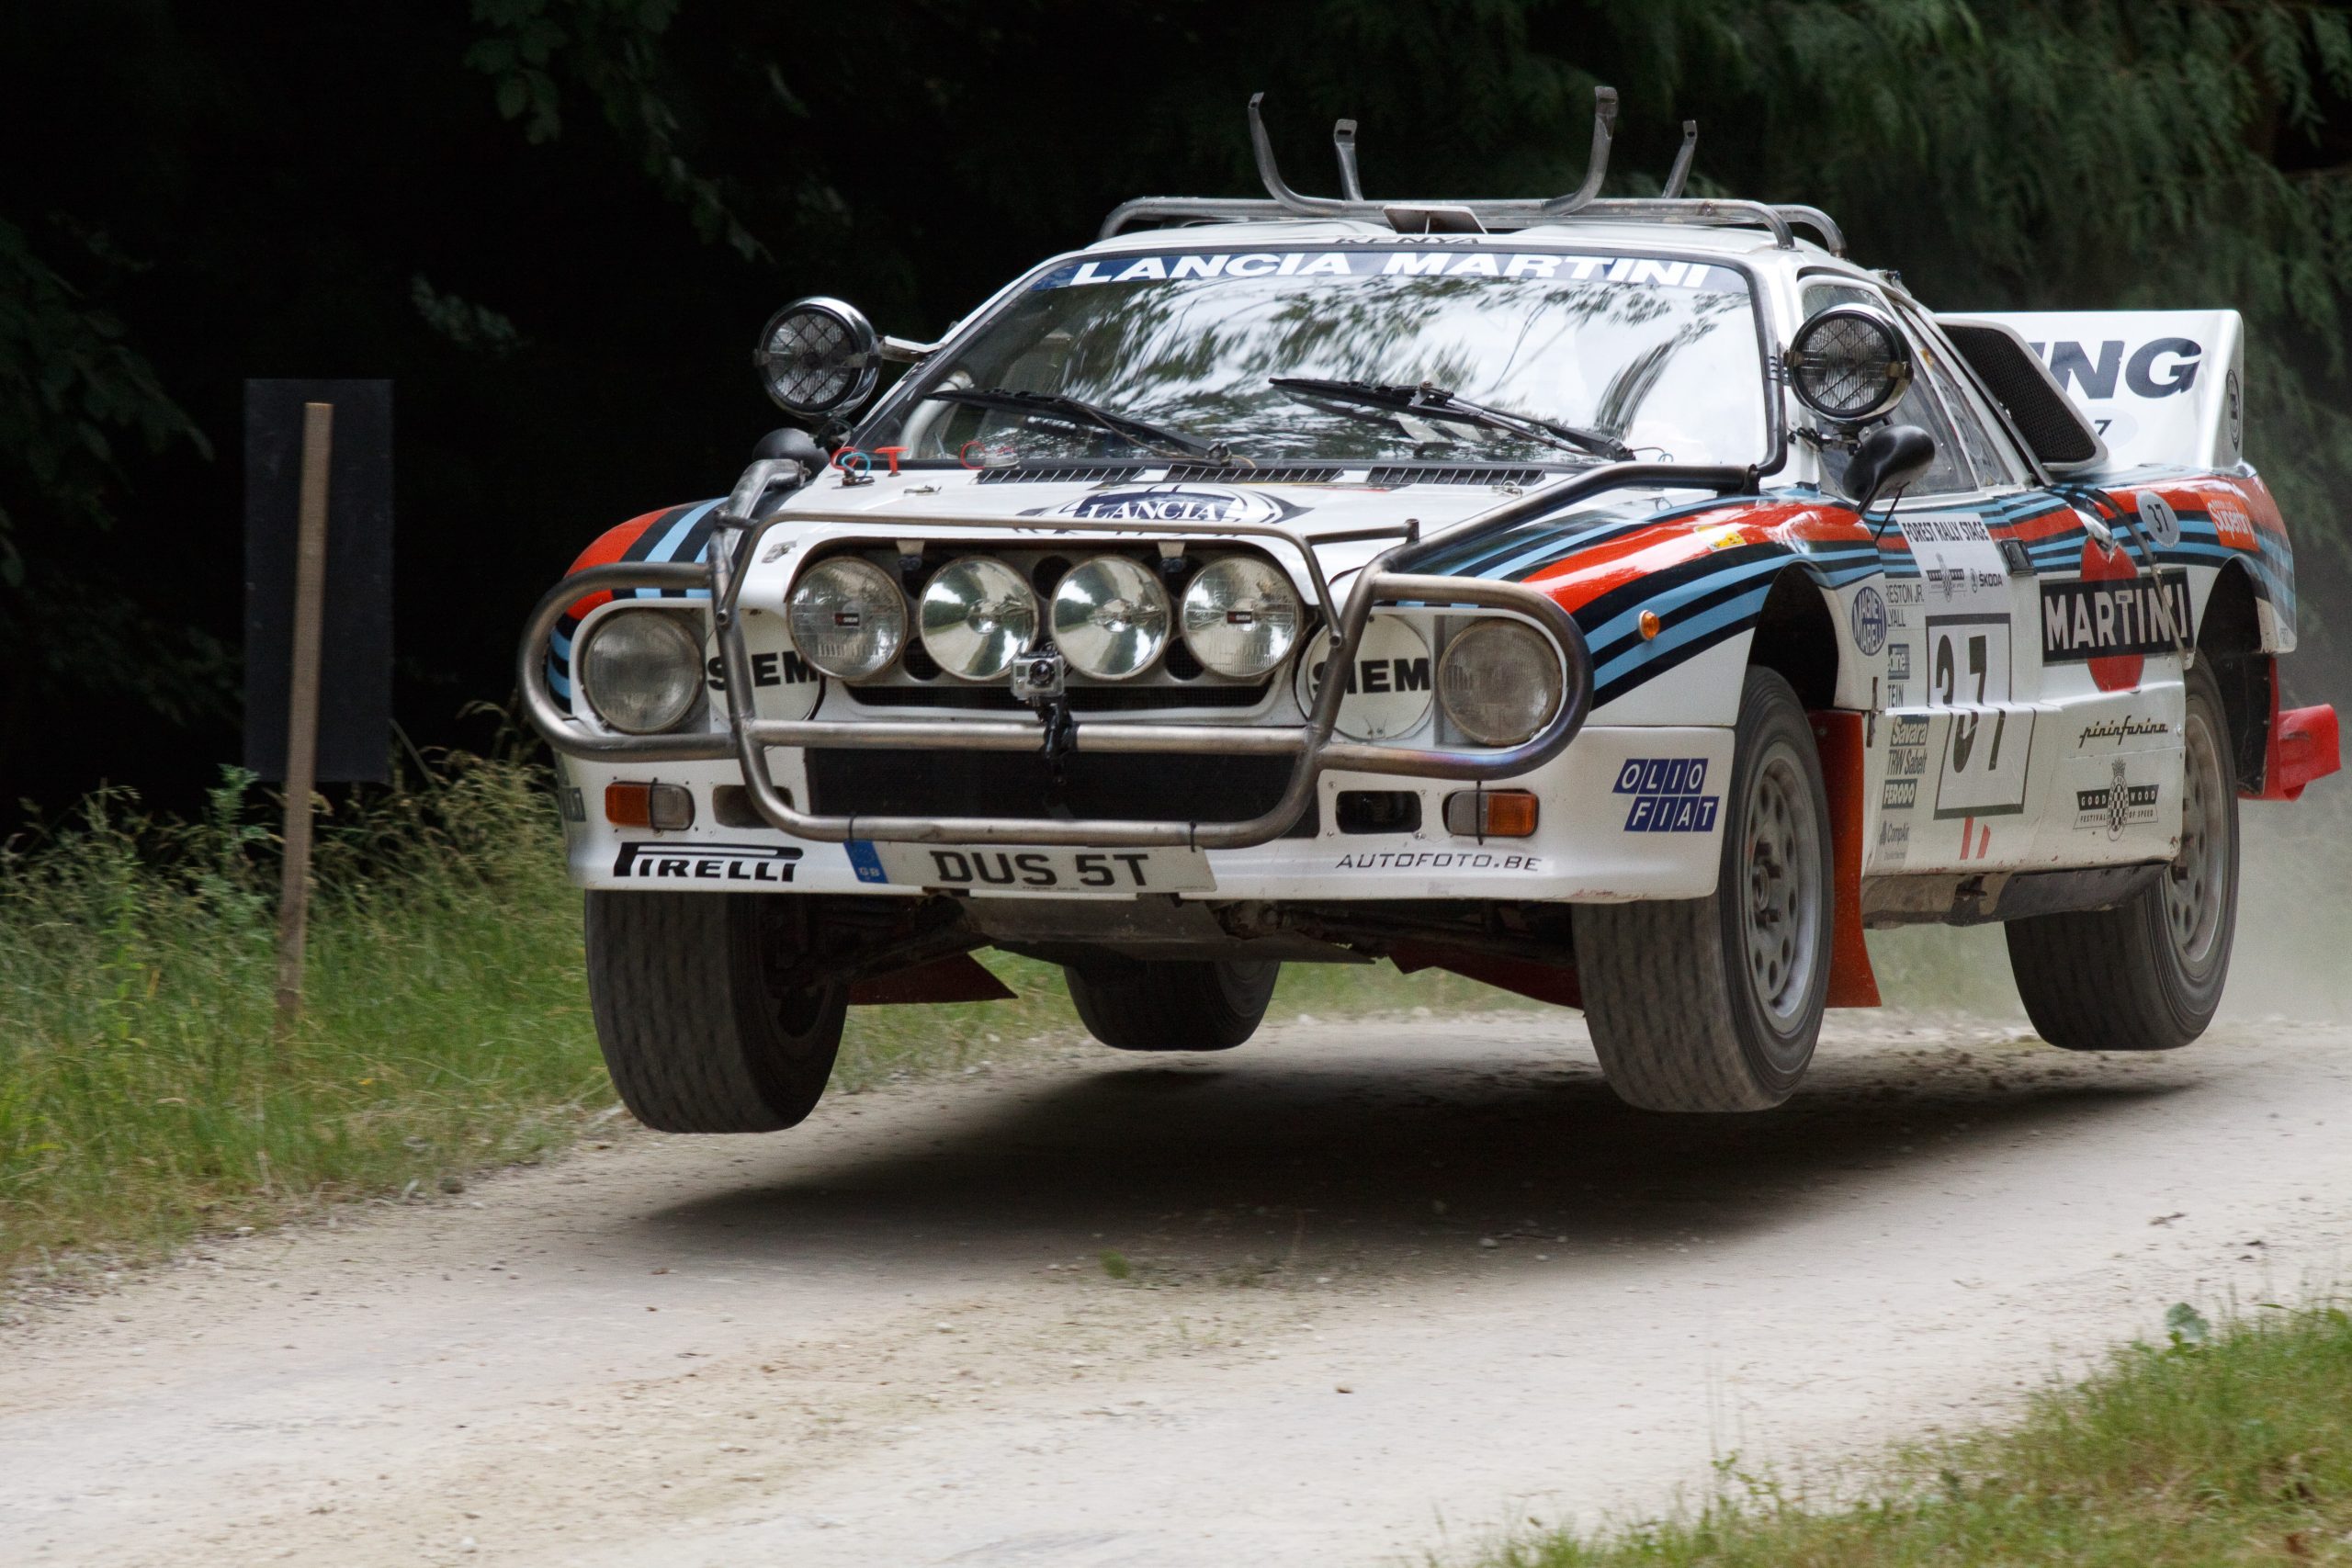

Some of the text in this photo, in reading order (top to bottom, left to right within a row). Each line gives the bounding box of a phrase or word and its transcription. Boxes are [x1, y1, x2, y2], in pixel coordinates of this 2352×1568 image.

[1069, 252, 1712, 288] LANCIA MARTINI
[1086, 501, 1219, 522] LANCIA
[2146, 503, 2170, 534] 37
[1902, 521, 1990, 543] FOREST RALLY STAGE
[1978, 570, 2004, 588] ŠKODA
[2044, 582, 2188, 652] MARTINI
[707, 650, 819, 692] SEM
[1936, 634, 2006, 773] 37
[1892, 716, 1928, 745] Savara
[2078, 714, 2168, 749] pininfarina
[1621, 762, 1703, 790] OLIO
[1887, 749, 1928, 775] TRW Sabelt
[1883, 783, 1915, 805] FERODO
[2080, 789, 2156, 807] GOOD WOOD
[1631, 801, 1714, 827] FIAT
[2079, 809, 2154, 823] FESTIVAL OF SPEED
[613, 841, 804, 883] PIRELLI
[858, 850, 1149, 887] GB DUS 5T
[1335, 852, 1543, 872] AUTOFOTO.BE
